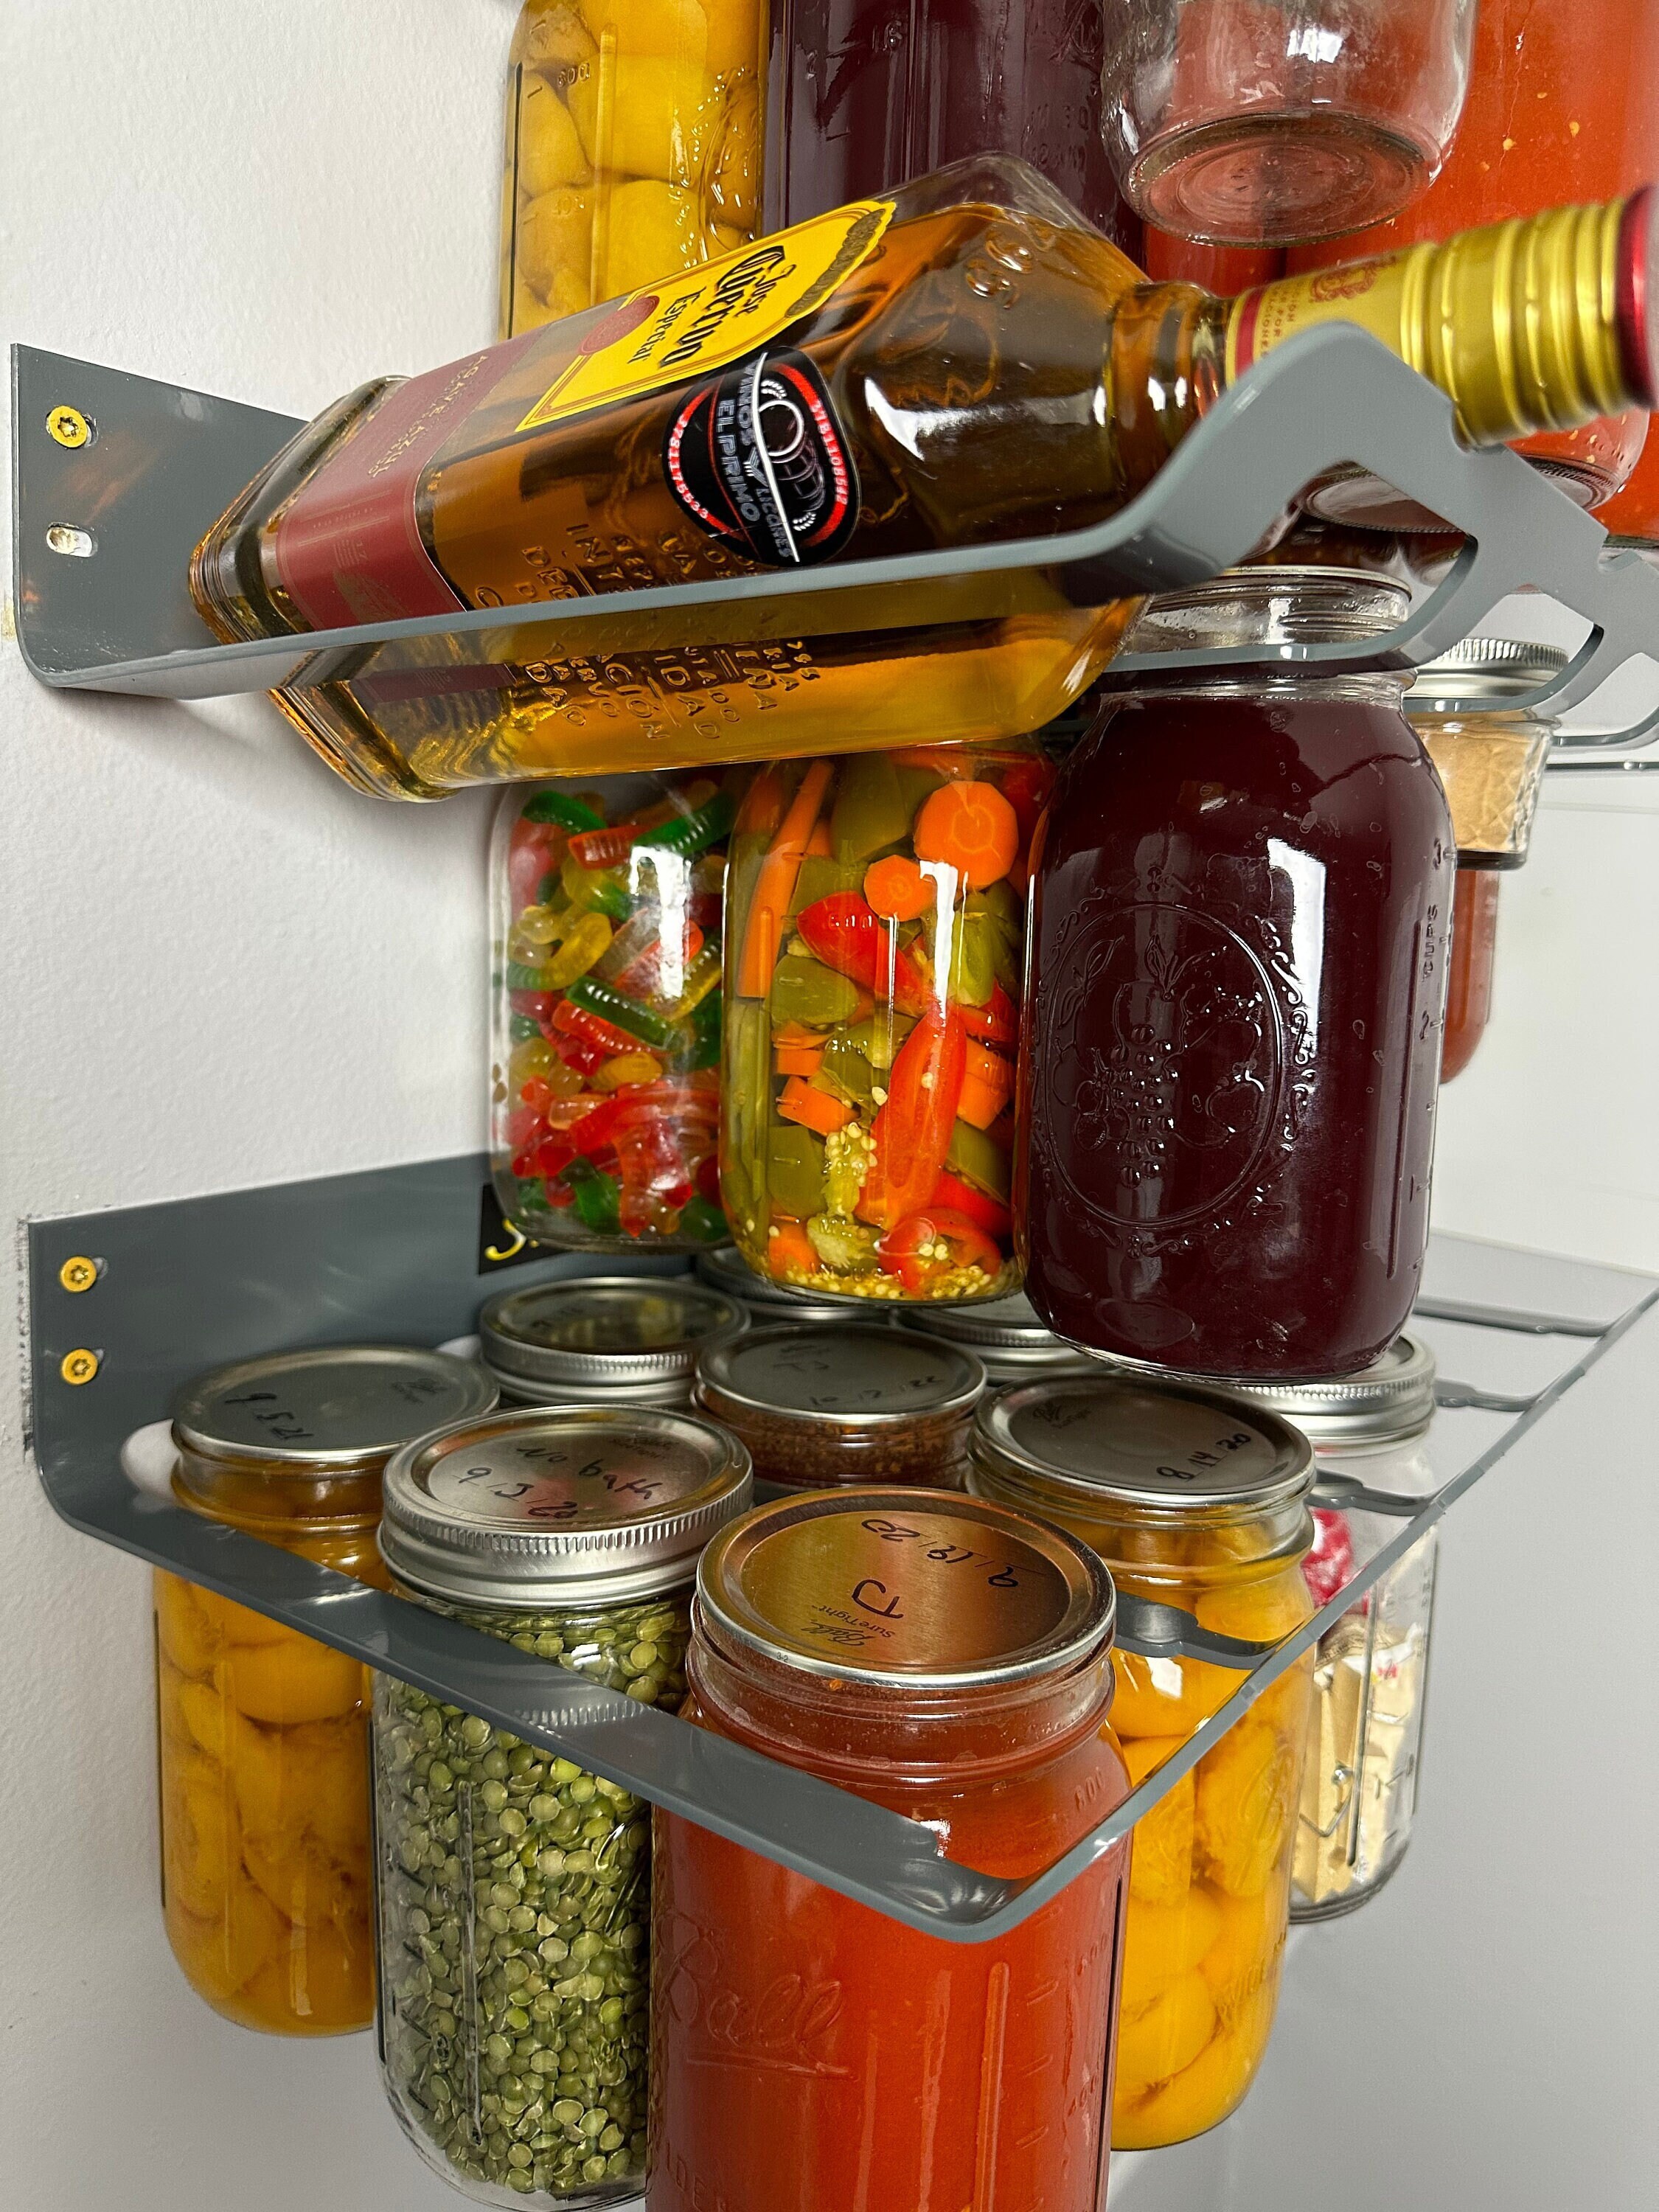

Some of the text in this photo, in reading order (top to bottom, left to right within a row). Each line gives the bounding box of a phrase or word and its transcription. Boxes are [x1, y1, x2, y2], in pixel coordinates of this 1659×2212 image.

[658, 245, 787, 369] Cuervo
[734, 263, 797, 317] Jose
[627, 285, 707, 365] Especial
[801, 1622, 866, 1647] Ball
